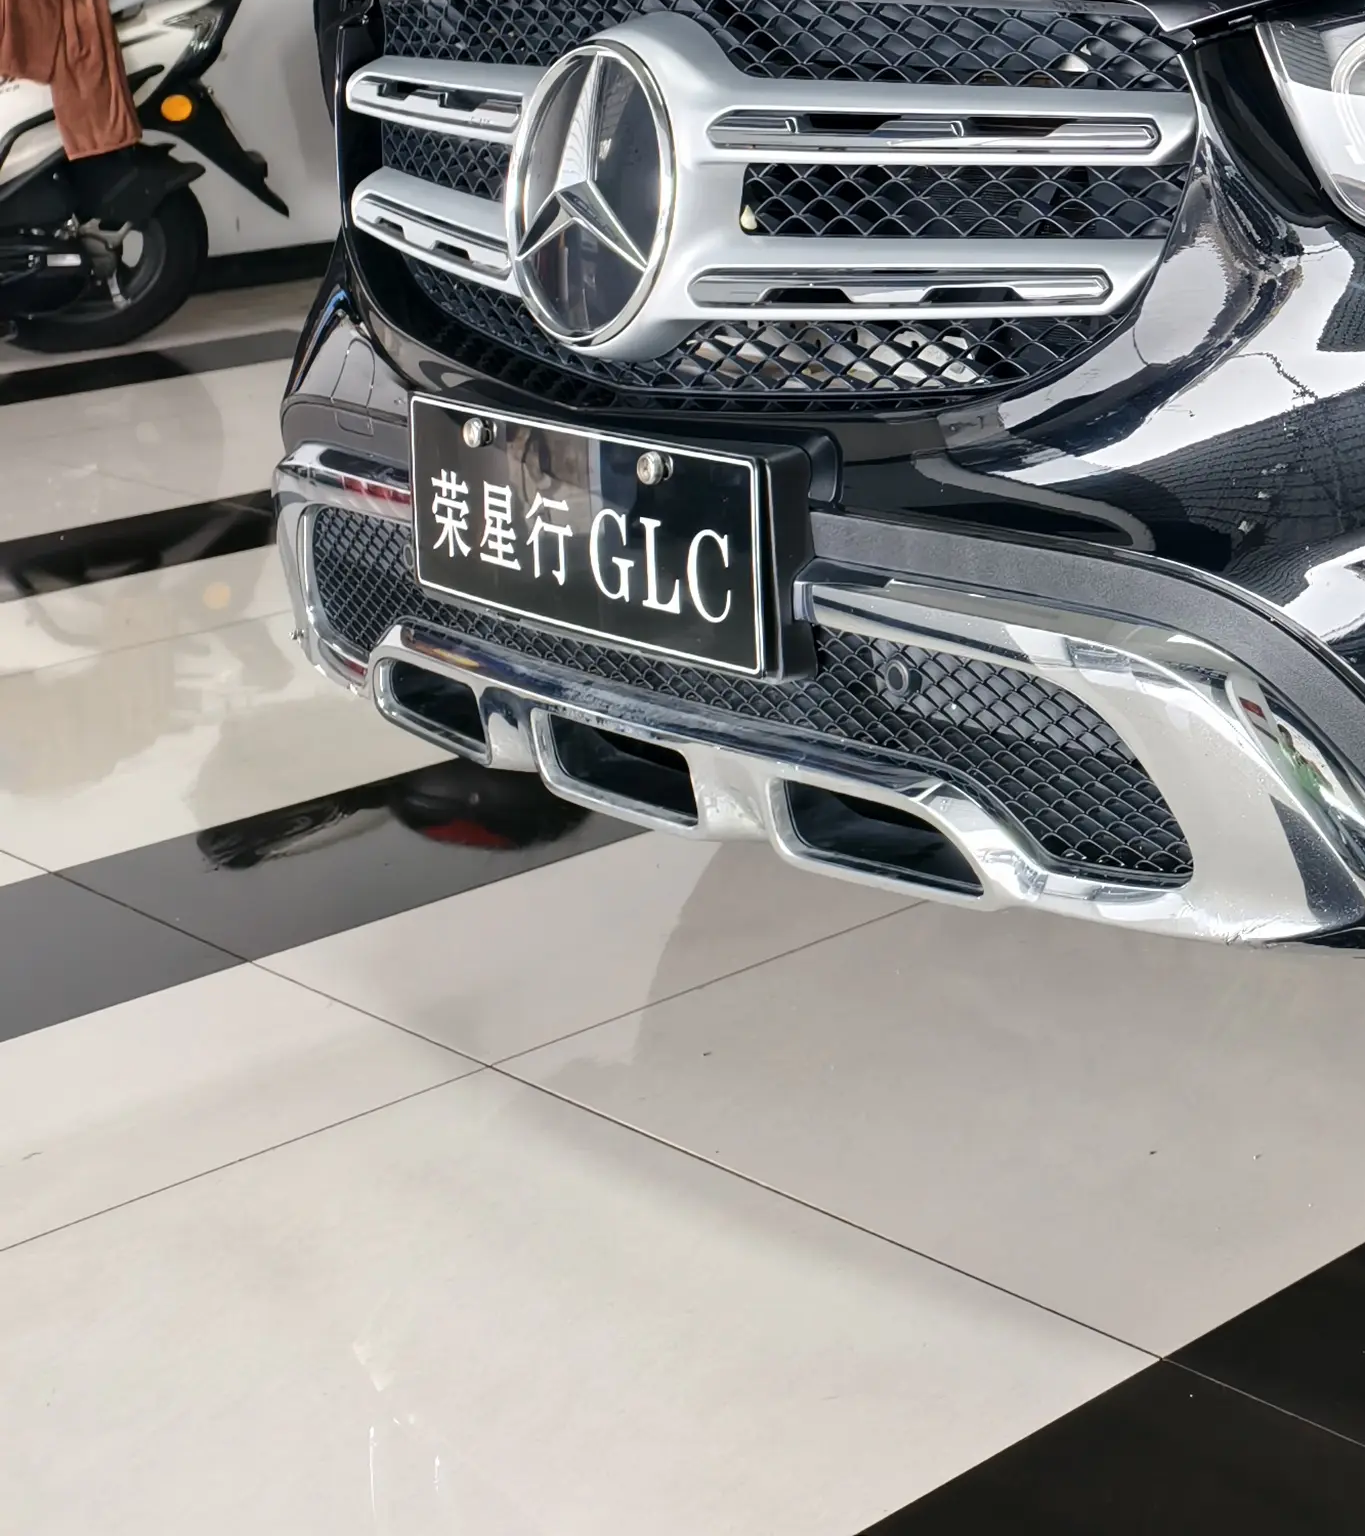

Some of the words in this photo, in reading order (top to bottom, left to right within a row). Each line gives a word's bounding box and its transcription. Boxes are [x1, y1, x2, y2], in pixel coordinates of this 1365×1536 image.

[430, 468, 574, 587] 荣星行
[589, 507, 732, 624] GLC
